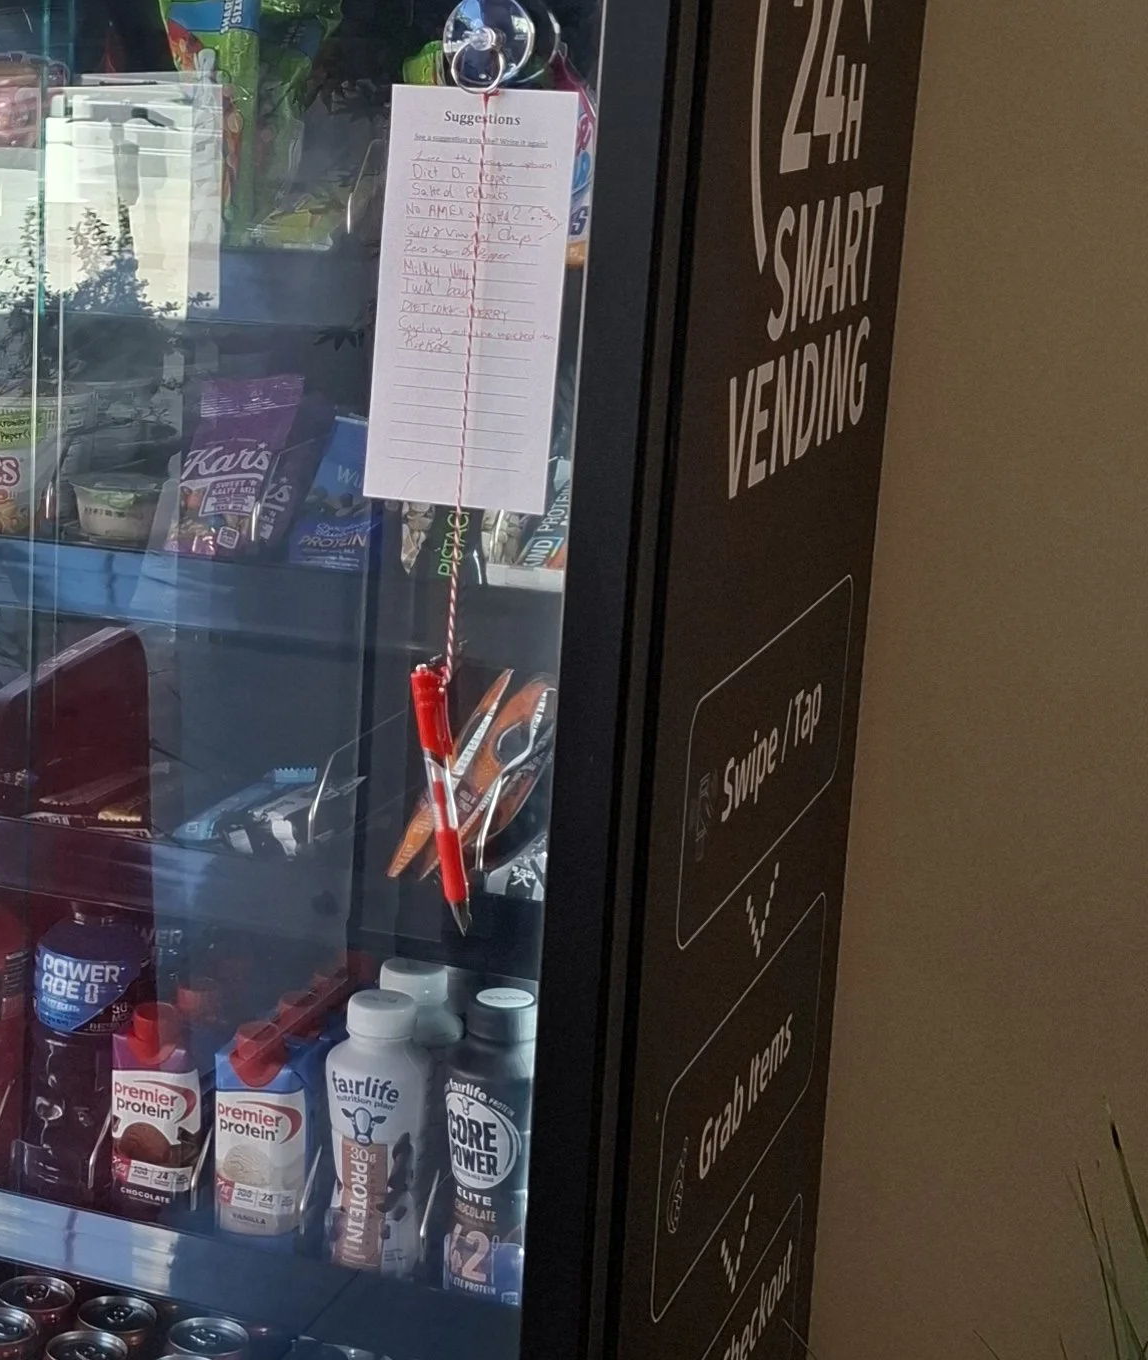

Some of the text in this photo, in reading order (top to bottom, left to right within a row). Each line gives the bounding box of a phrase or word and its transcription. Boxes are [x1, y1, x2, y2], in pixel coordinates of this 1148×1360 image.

[766, 185, 884, 343] SMART
[727, 316, 871, 500] VENDING
[721, 683, 822, 822] Swipe / Tap
[42, 953, 120, 983] POWER
[42, 973, 79, 1000] ADE
[114, 1081, 178, 1107] premier
[332, 1071, 400, 1104] fairlife
[699, 1013, 793, 1179] Grab Items
[116, 1096, 171, 1120] protein
[217, 1101, 283, 1127] premier
[220, 1117, 276, 1141] protein
[449, 1108, 498, 1153] CORE
[120, 1187, 171, 1204] CHOCOLATE
[346, 1159, 368, 1250] PROTEIN
[457, 1185, 492, 1207] ELITE
